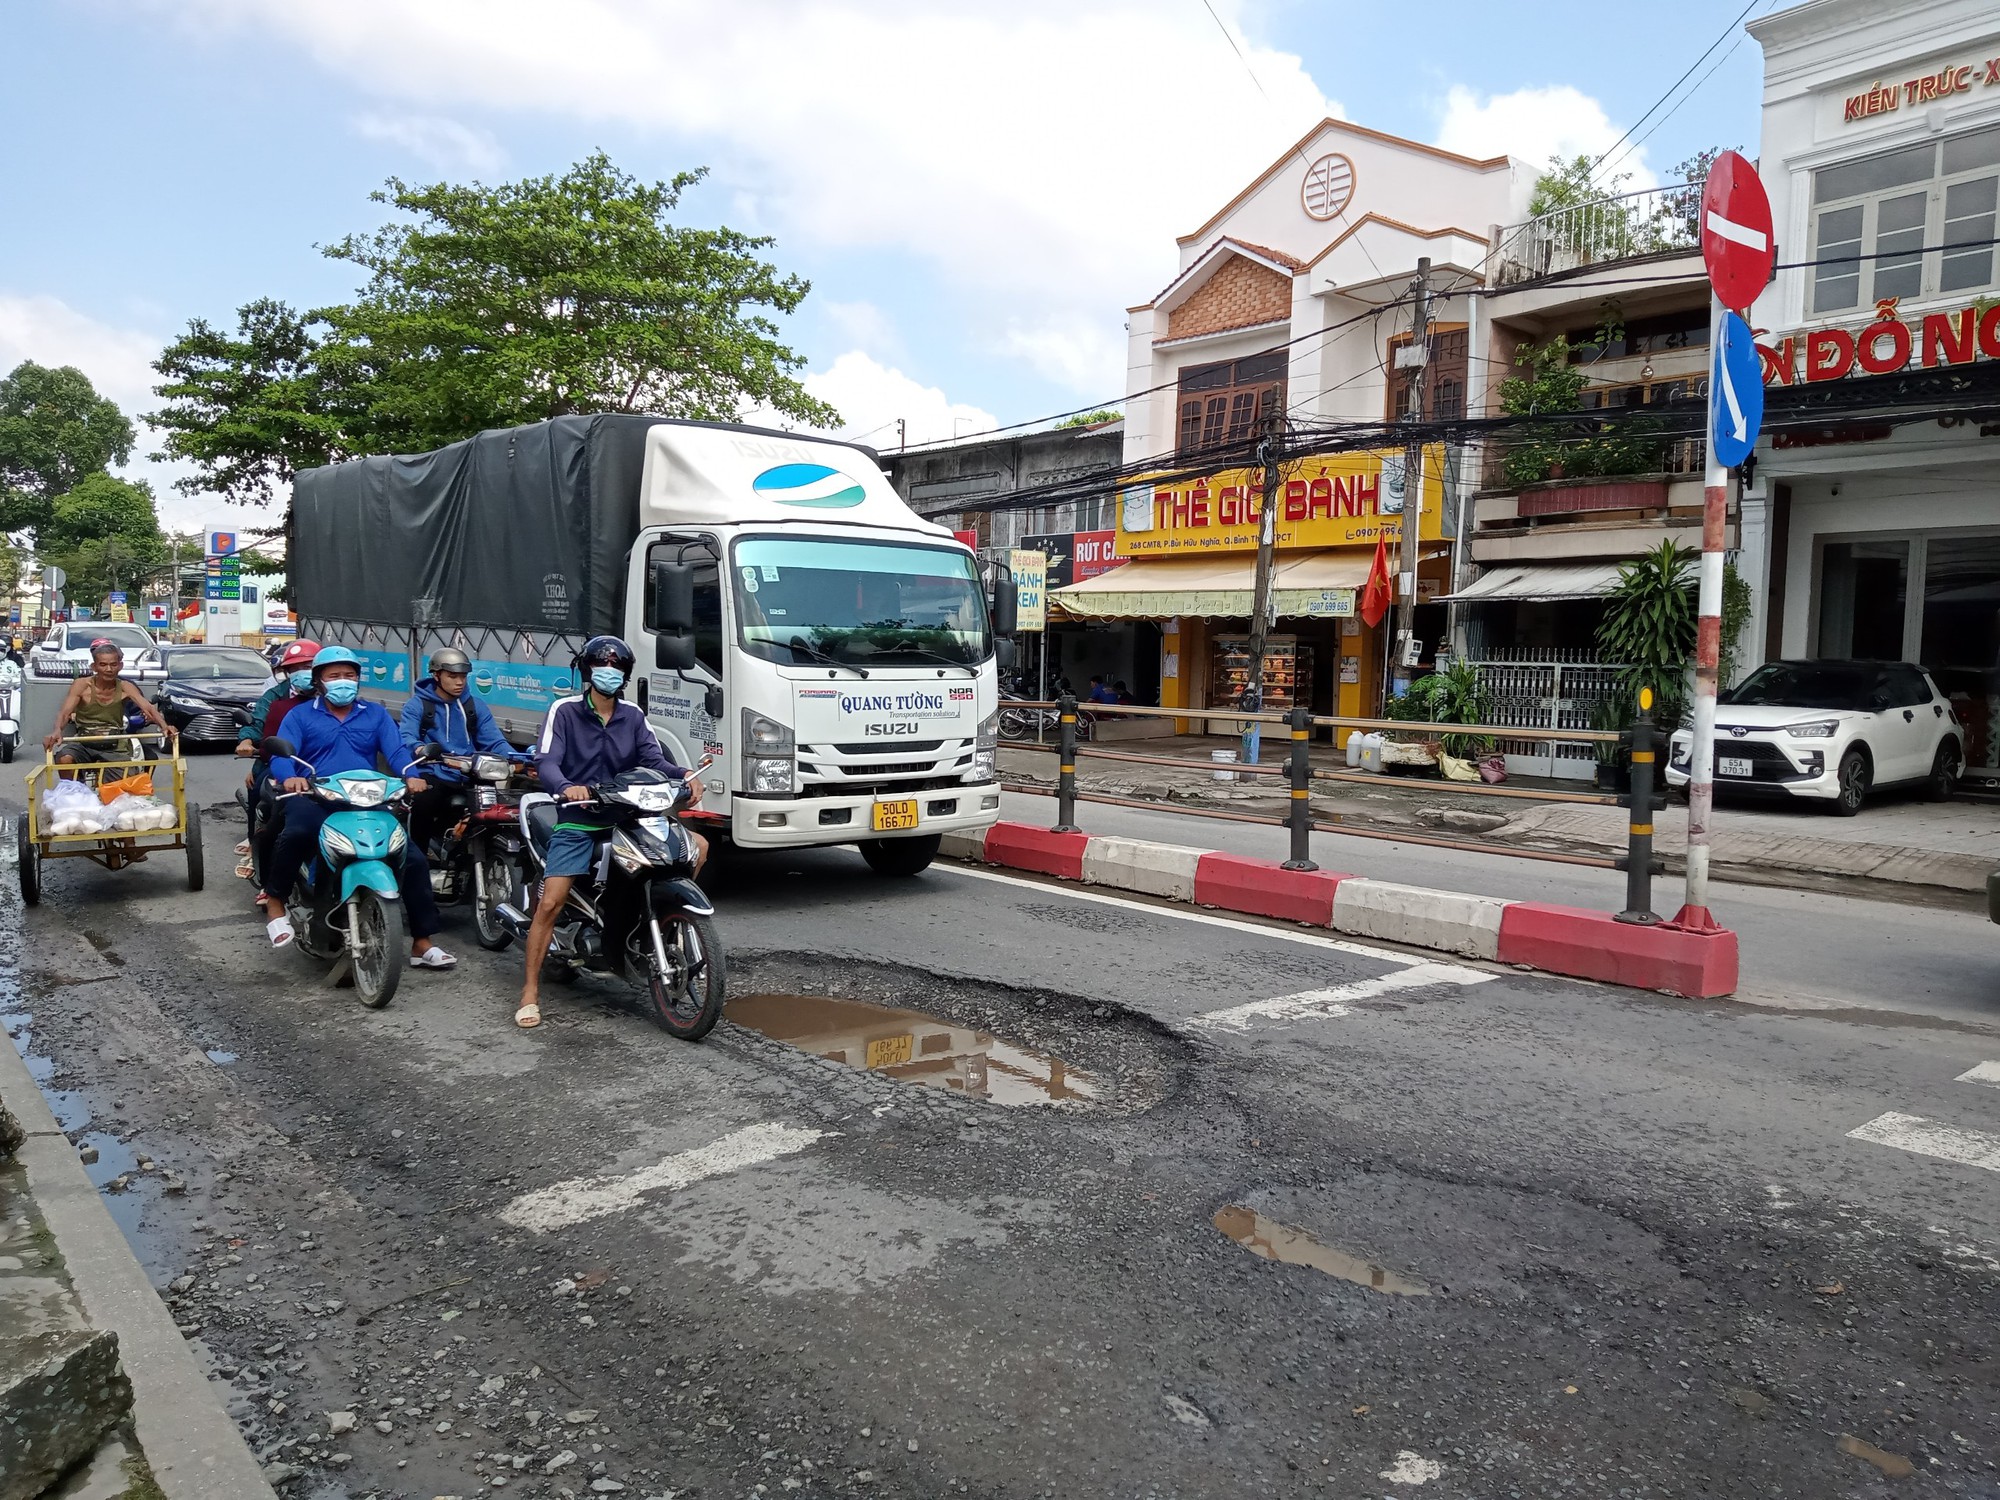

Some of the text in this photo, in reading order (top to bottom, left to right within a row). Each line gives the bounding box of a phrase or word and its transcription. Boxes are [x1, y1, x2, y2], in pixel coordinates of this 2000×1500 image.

[1844, 81, 1899, 122] KIẾN
[730, 440, 816, 463] ISUZU
[1154, 467, 1380, 529] THẾ GIỚ BÁNH
[1355, 528, 1379, 537] 0907
[1076, 538, 1100, 563] RÚT
[1129, 541, 1142, 550] 268
[1012, 568, 1043, 588] BÁNH
[1309, 602, 1324, 611] 0907
[1324, 602, 1336, 611] 699
[841, 691, 943, 713] QUANG TƯỜNG
[865, 722, 919, 736] ISUZU
[1722, 766, 1749, 775] 370.31
[882, 802, 908, 815] 50LD
[880, 815, 913, 828] 166.77
